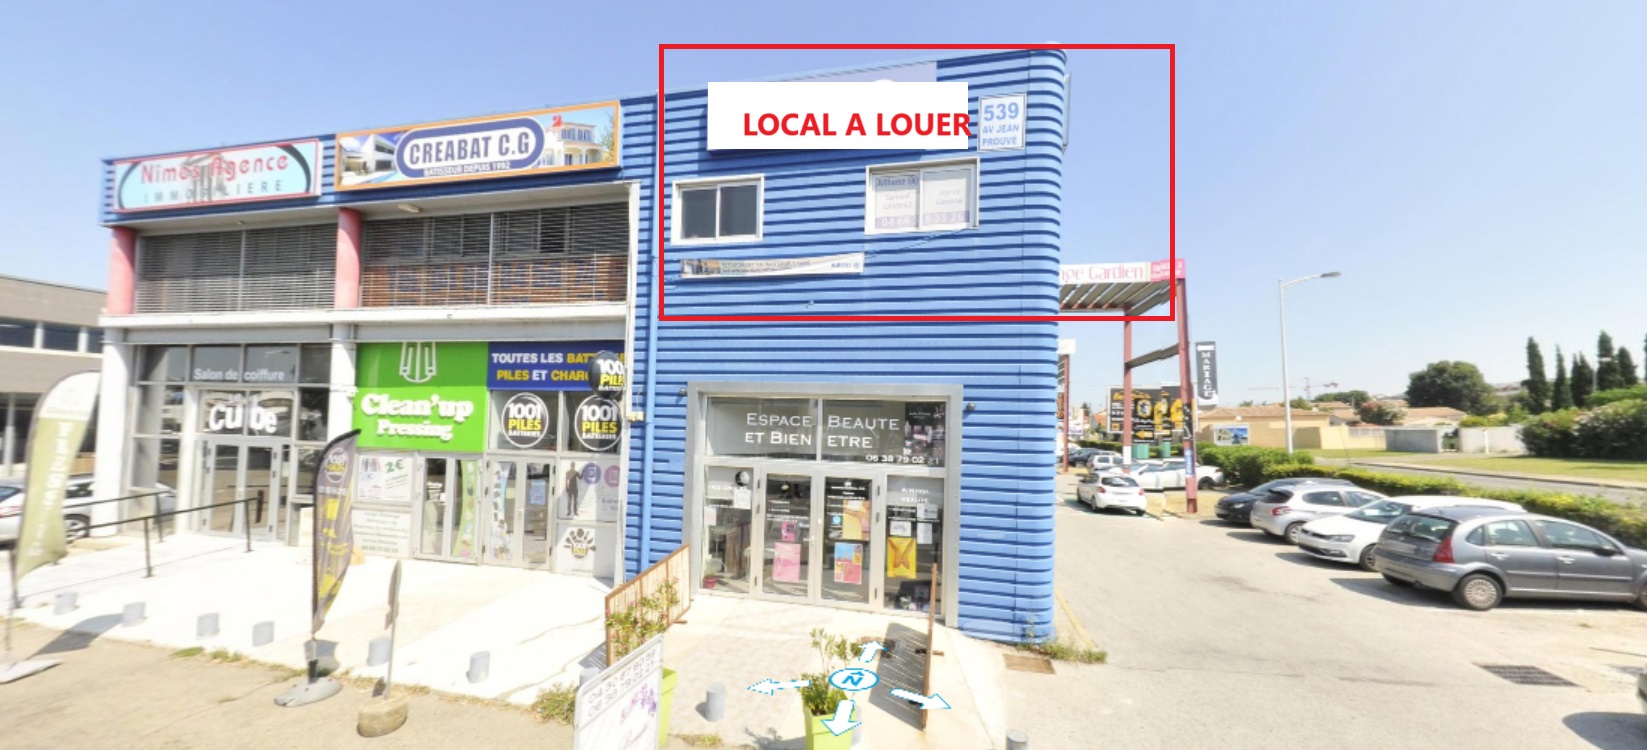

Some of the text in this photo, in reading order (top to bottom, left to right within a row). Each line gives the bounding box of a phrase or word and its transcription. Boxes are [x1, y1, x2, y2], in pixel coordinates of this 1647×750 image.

[983, 102, 1020, 122] 539
[982, 123, 1020, 135] AV JEAN
[409, 131, 530, 166] CREABAT C.G
[209, 154, 289, 182] Agence
[1088, 264, 1143, 281] Gardien
[491, 353, 538, 364] TOUTES
[540, 353, 564, 364] LES
[597, 358, 625, 375] 100
[194, 368, 286, 381] Salon de coiffure
[496, 370, 589, 381] PILES ET CHAR
[600, 373, 625, 386] PILE
[361, 393, 475, 423] Clean'up
[508, 403, 543, 418] 1001
[582, 405, 618, 421] 1001
[508, 418, 543, 431] PILES
[582, 420, 618, 434] PILES
[746, 412, 813, 428] ESPACE
[827, 414, 901, 431] BEAUTE
[377, 419, 454, 442] Pressing
[770, 431, 813, 446] BIEN
[827, 435, 874, 449] ETRE
[881, 454, 894, 463] 38
[897, 455, 910, 464] 79
[912, 456, 925, 465] 02
[927, 457, 940, 466] 21
